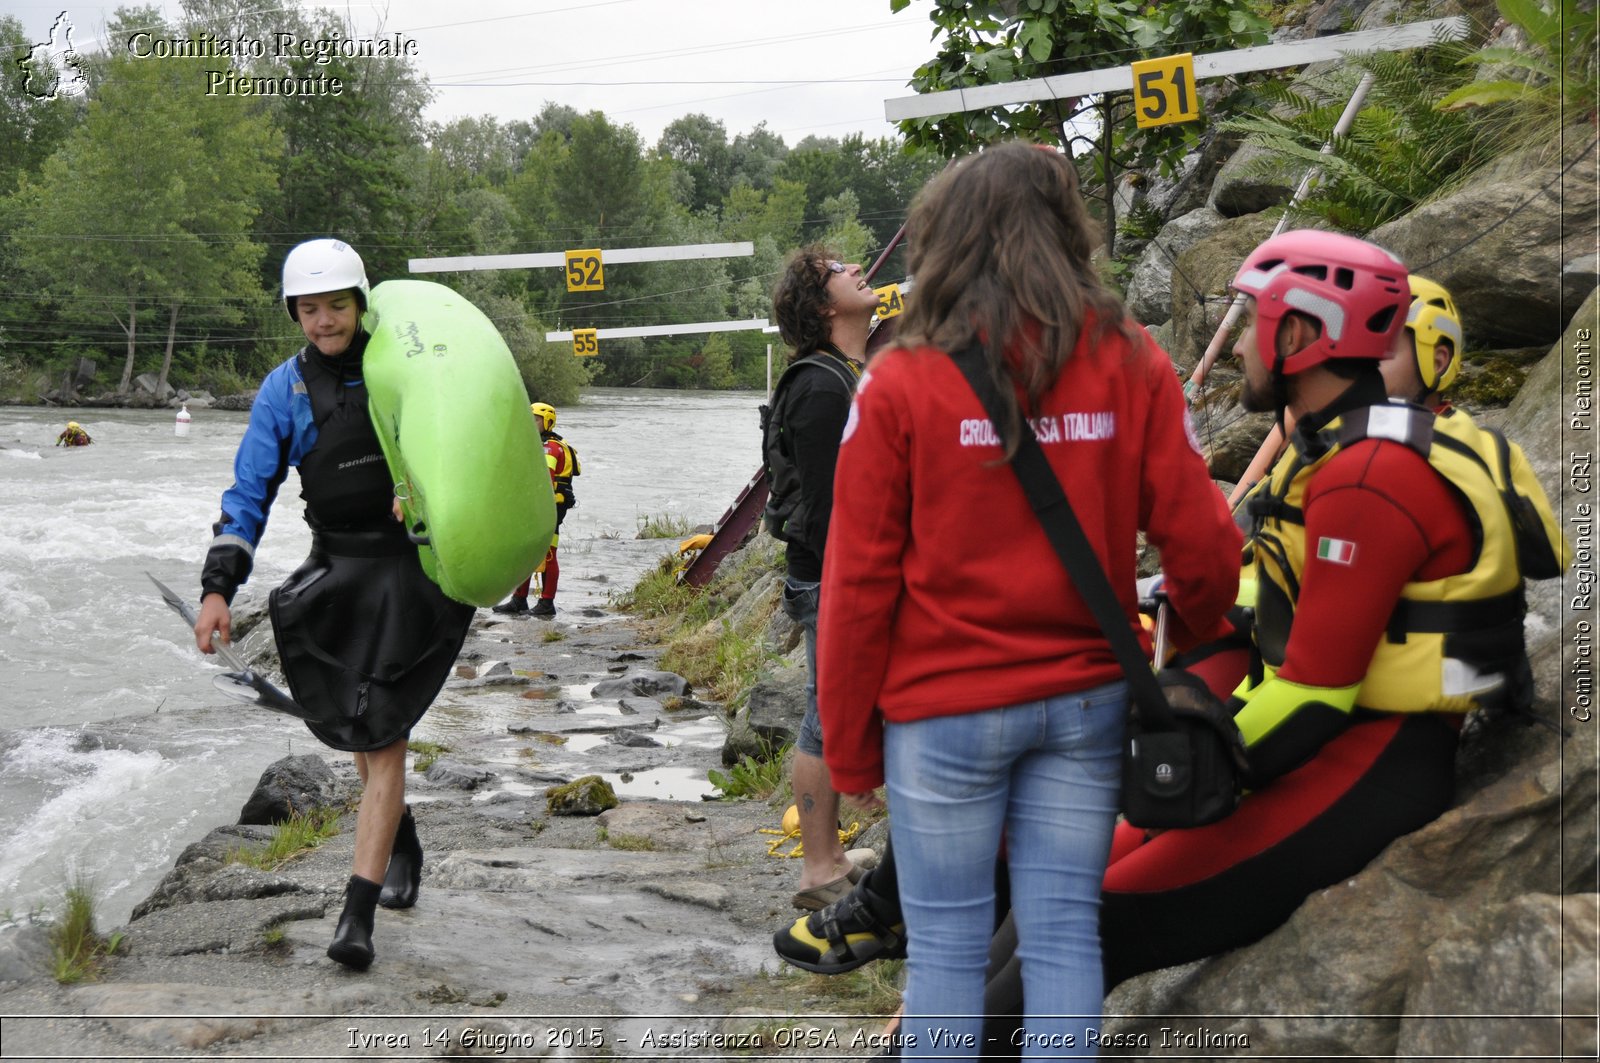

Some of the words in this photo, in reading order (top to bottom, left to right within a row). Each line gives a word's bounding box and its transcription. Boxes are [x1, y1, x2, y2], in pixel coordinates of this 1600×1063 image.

[1139, 66, 1189, 119] 51
[568, 257, 601, 286] 52
[877, 290, 901, 315] 54
[573, 334, 596, 353] 55
[960, 418, 1002, 446] CROC
[1064, 411, 1115, 441] ITALIANA
